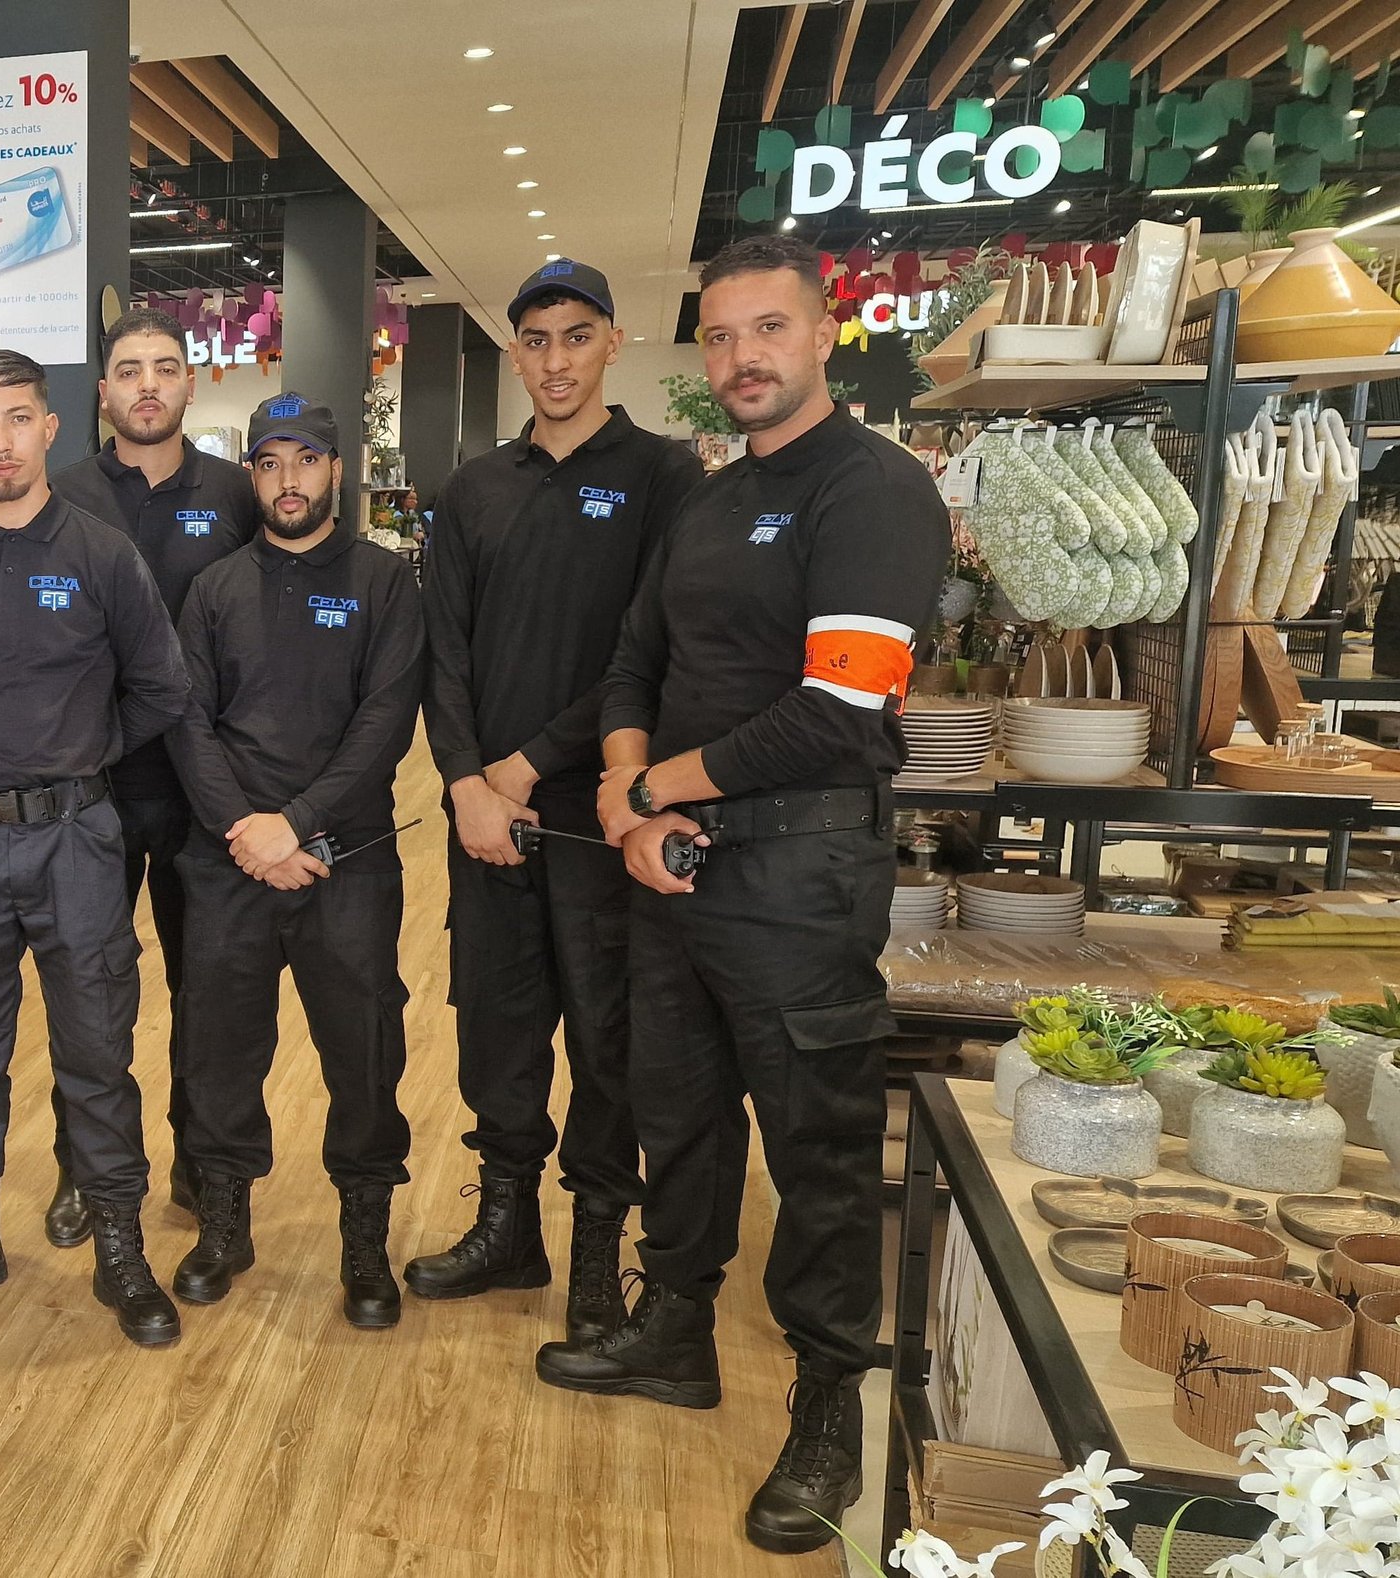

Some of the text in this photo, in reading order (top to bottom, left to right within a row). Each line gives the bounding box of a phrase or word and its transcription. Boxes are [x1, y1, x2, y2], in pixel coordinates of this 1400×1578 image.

[19, 73, 78, 107] 10%
[11, 123, 42, 135] achats
[790, 114, 1061, 215] DÉCO
[25, 294, 36, 303] de
[39, 292, 79, 301] 1000dhs
[862, 290, 950, 333] CU
[39, 324, 49, 333] de
[50, 324, 57, 333] la
[58, 323, 80, 332] carte
[579, 486, 626, 504] CELYA
[176, 510, 217, 520] CELYA
[584, 500, 612, 518] CTS
[186, 521, 209, 537] CTS
[750, 527, 778, 544] CTS
[29, 576, 80, 591] CELYA
[40, 591, 69, 610] CTS
[308, 595, 359, 611] CELYA
[316, 610, 346, 628] CTS
